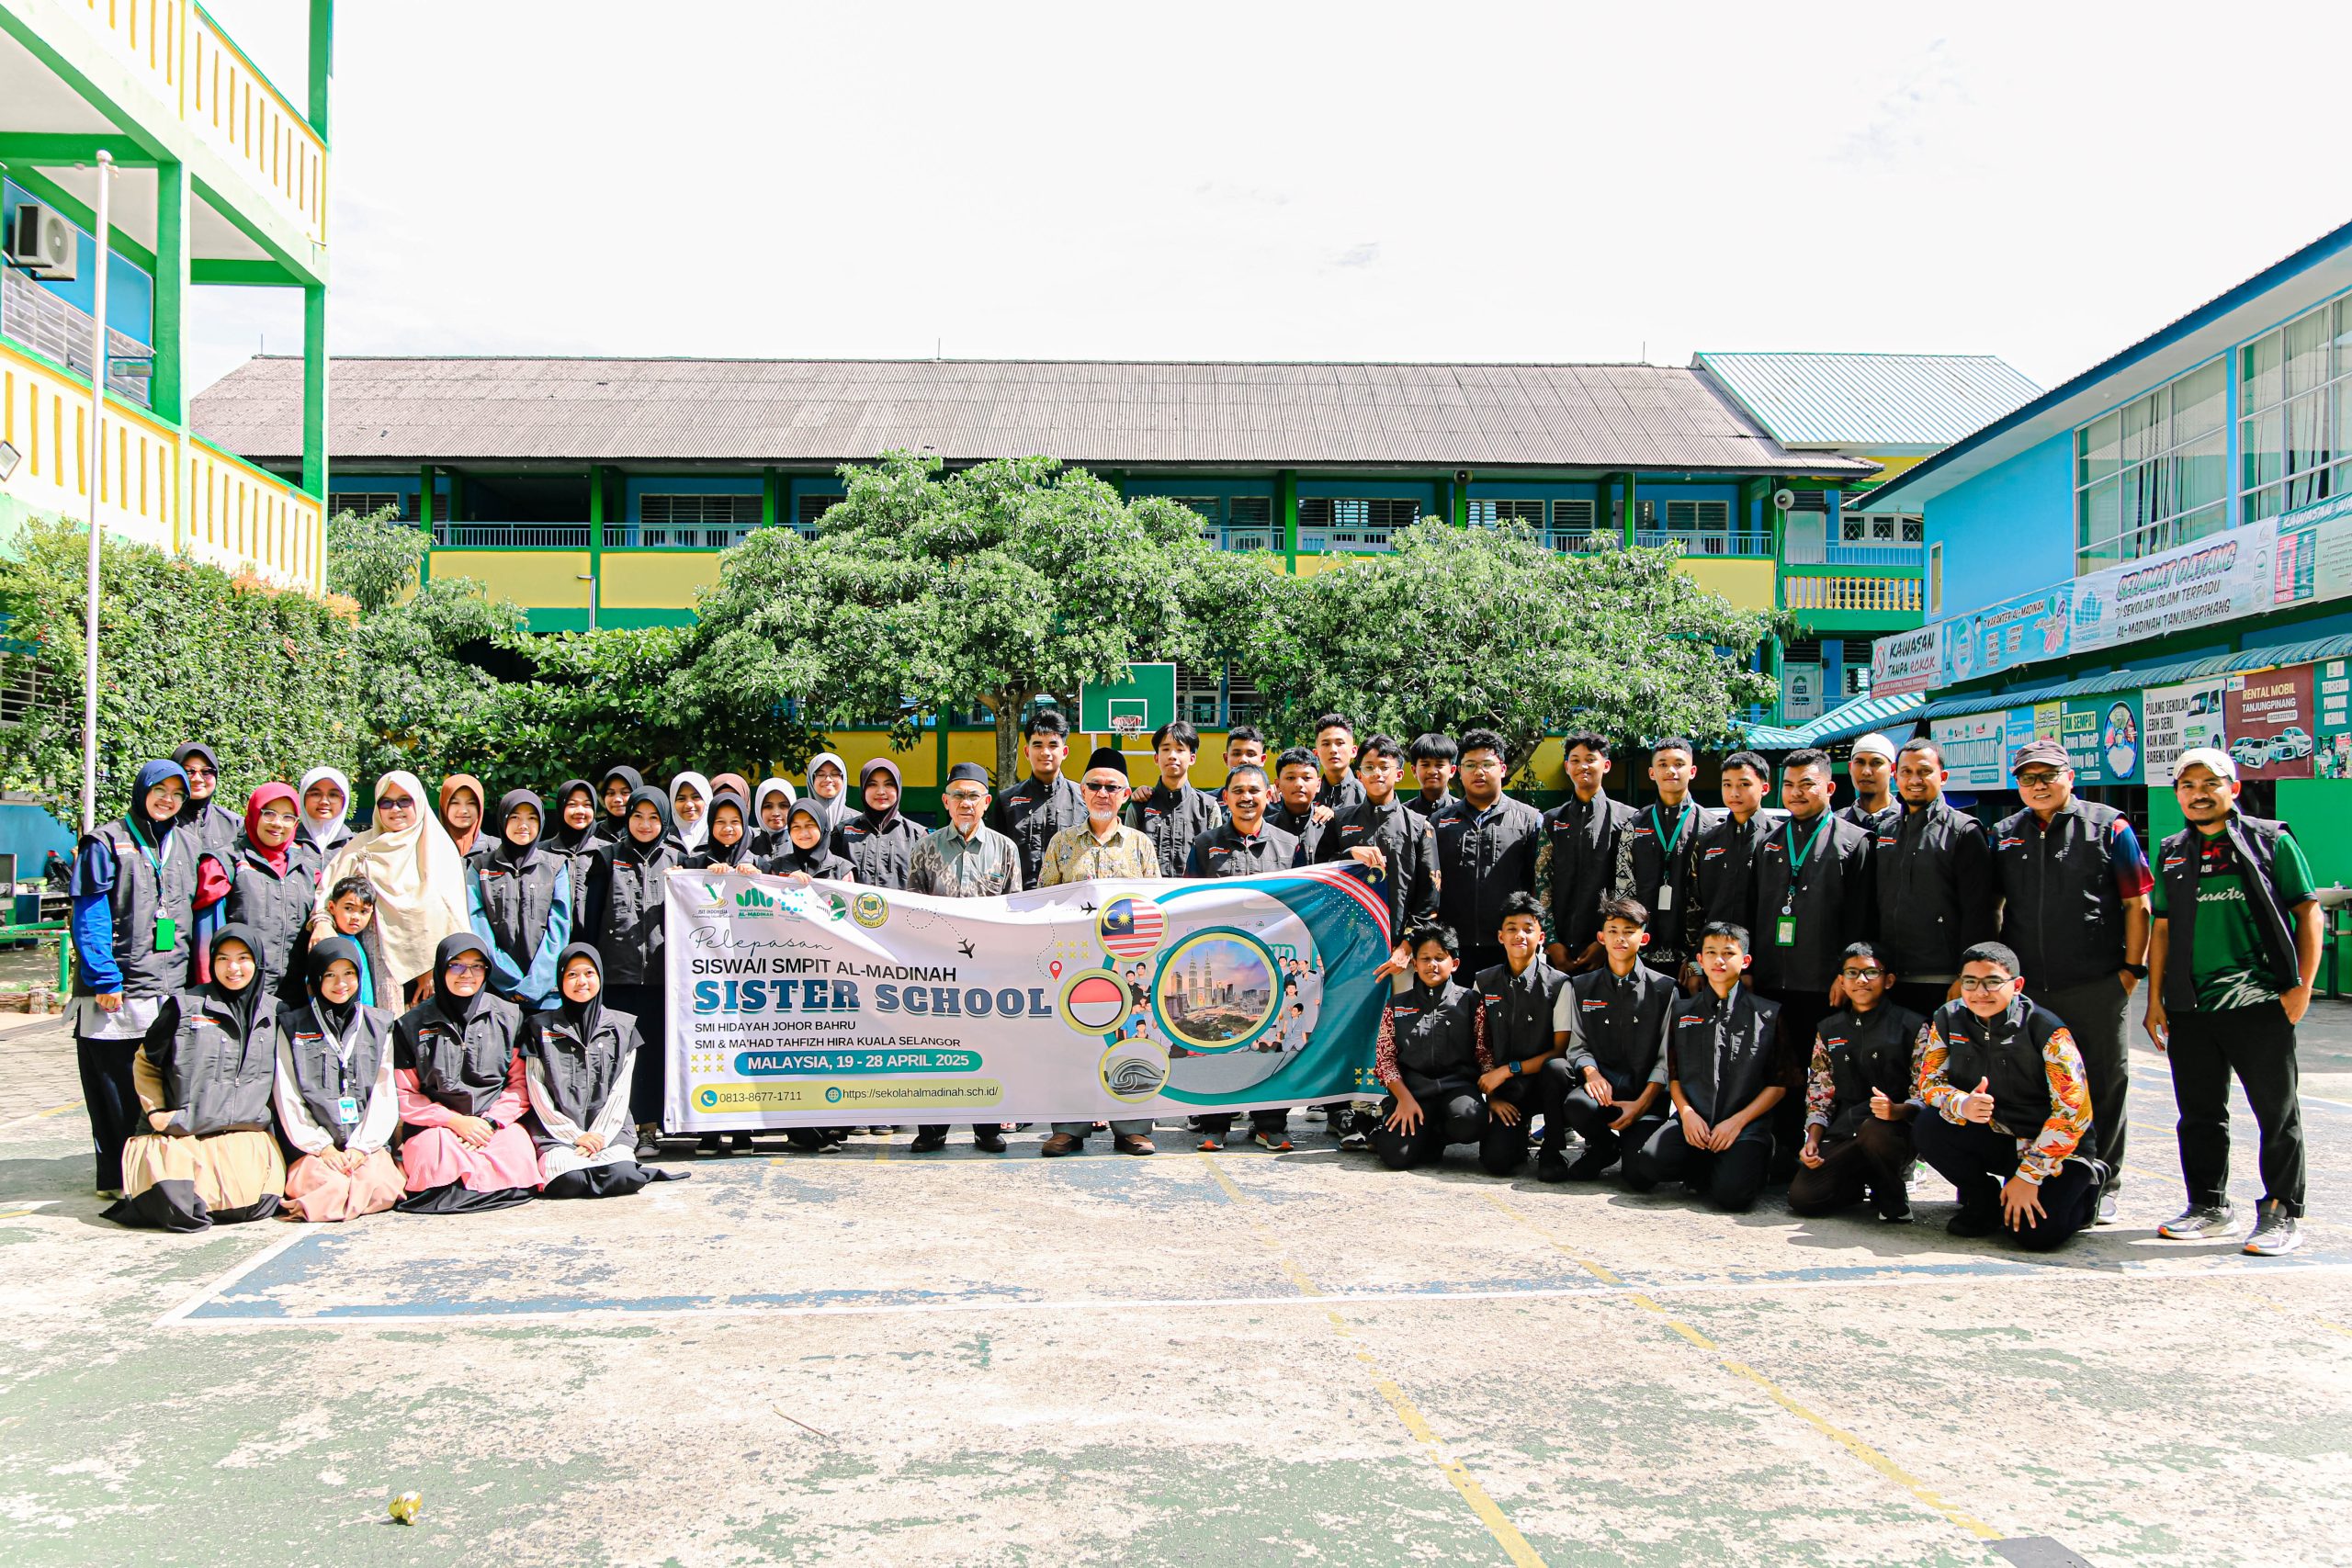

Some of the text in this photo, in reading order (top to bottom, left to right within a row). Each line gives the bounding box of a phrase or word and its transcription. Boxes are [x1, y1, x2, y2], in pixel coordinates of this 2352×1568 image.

[2116, 540, 2237, 602] SELAMAT DATANG
[2123, 598, 2154, 617] SEKOLAH
[2155, 590, 2179, 608] ISLAM
[2182, 580, 2221, 602] TERPADU
[2117, 598, 2231, 638] AL-MADINAH TANJUNGPINANG
[1890, 631, 1935, 660] KAWASAN
[1888, 655, 1936, 678] TANPA ROKOK
[2242, 682, 2296, 701] RENTAL MOBIL
[2146, 697, 2188, 716] PULANG SEKOLAH
[2242, 697, 2296, 714] TANJUNGPINANG
[2063, 716, 2072, 730] TAK
[2074, 714, 2095, 729] SEMPAT
[2146, 716, 2173, 731] LEBIH SERU
[2146, 732, 2178, 748] NAIK ANGKOT
[2146, 750, 2165, 763] BARENG
[689, 926, 833, 956] Pelepasan
[691, 957, 956, 983] SISWA/I SMPIT AL-MADINAH
[693, 979, 1053, 1019] SISTER SCHOOL
[695, 1021, 856, 1032] SMI HIDAYAH JOHOR BAHRU
[695, 1036, 961, 1049] SMI & MA'HAD TAHFIZH HIRA KUALA SELANGOR
[748, 1055, 833, 1070] MALAYSIA,
[836, 1055, 854, 1068] 19
[865, 1055, 883, 1067] 28
[886, 1055, 933, 1067] APRIL
[935, 1054, 969, 1066] 2025
[718, 1091, 802, 1103] 0813-8677-1711
[842, 1086, 999, 1100] https://sekolahalmadinah.sch.id/
